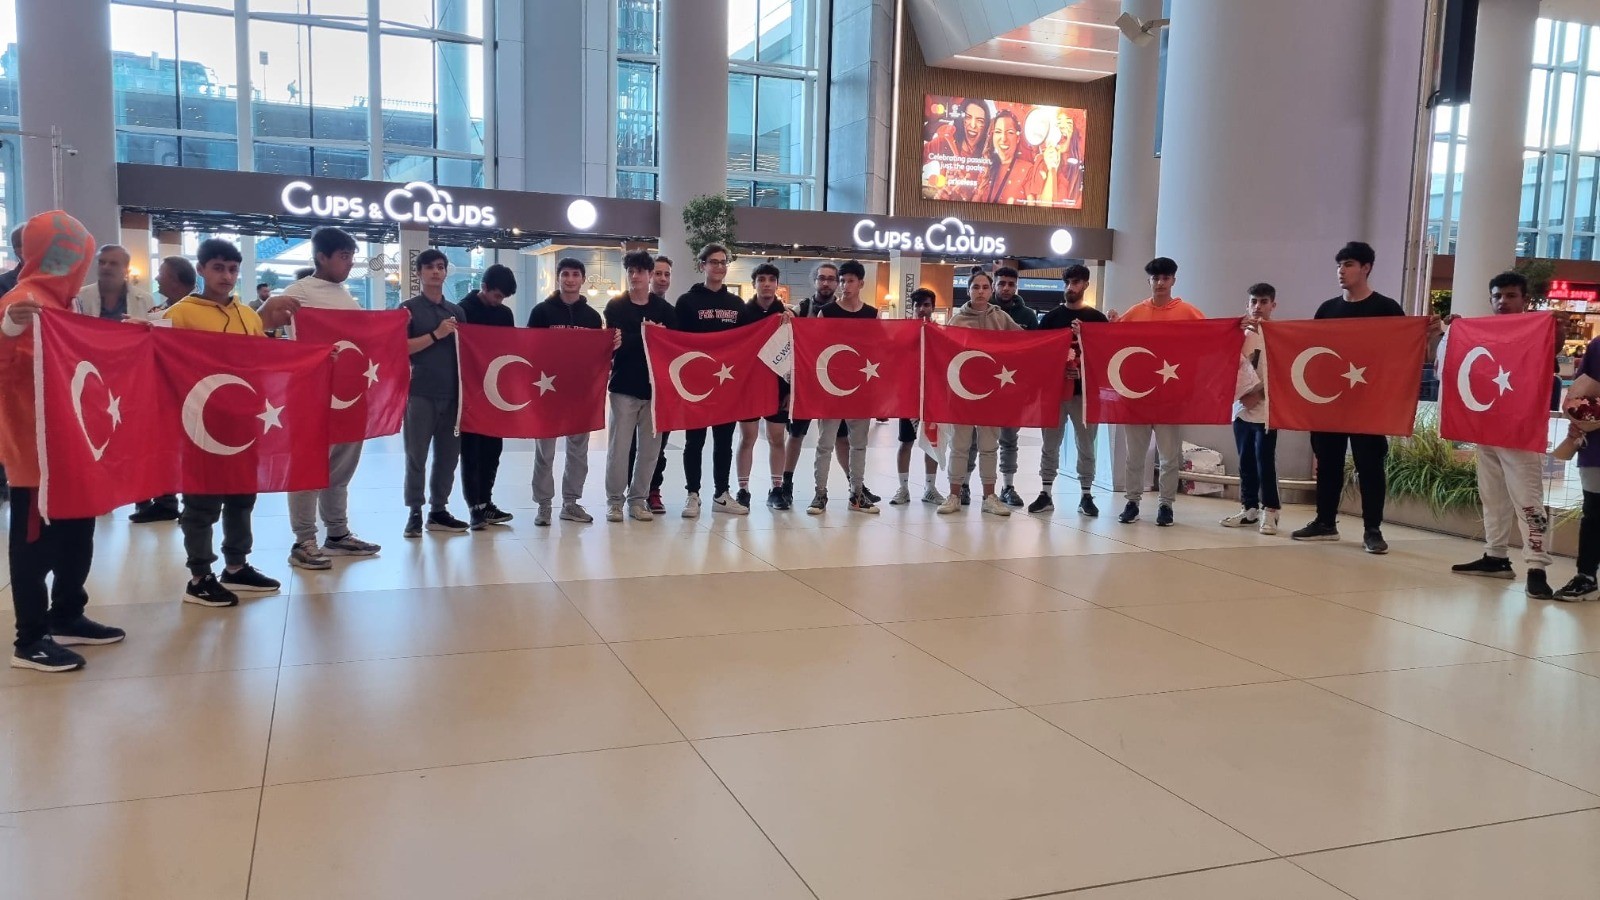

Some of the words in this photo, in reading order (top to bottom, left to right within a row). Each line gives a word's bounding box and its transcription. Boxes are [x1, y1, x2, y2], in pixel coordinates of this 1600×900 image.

[928, 153, 965, 163] Celebrating
[281, 181, 365, 218] CUPS
[368, 205, 383, 220] &
[384, 186, 496, 226] CLOUDS
[853, 219, 911, 249] CUPS
[914, 236, 925, 250] &
[926, 221, 1006, 254] CLOUDS
